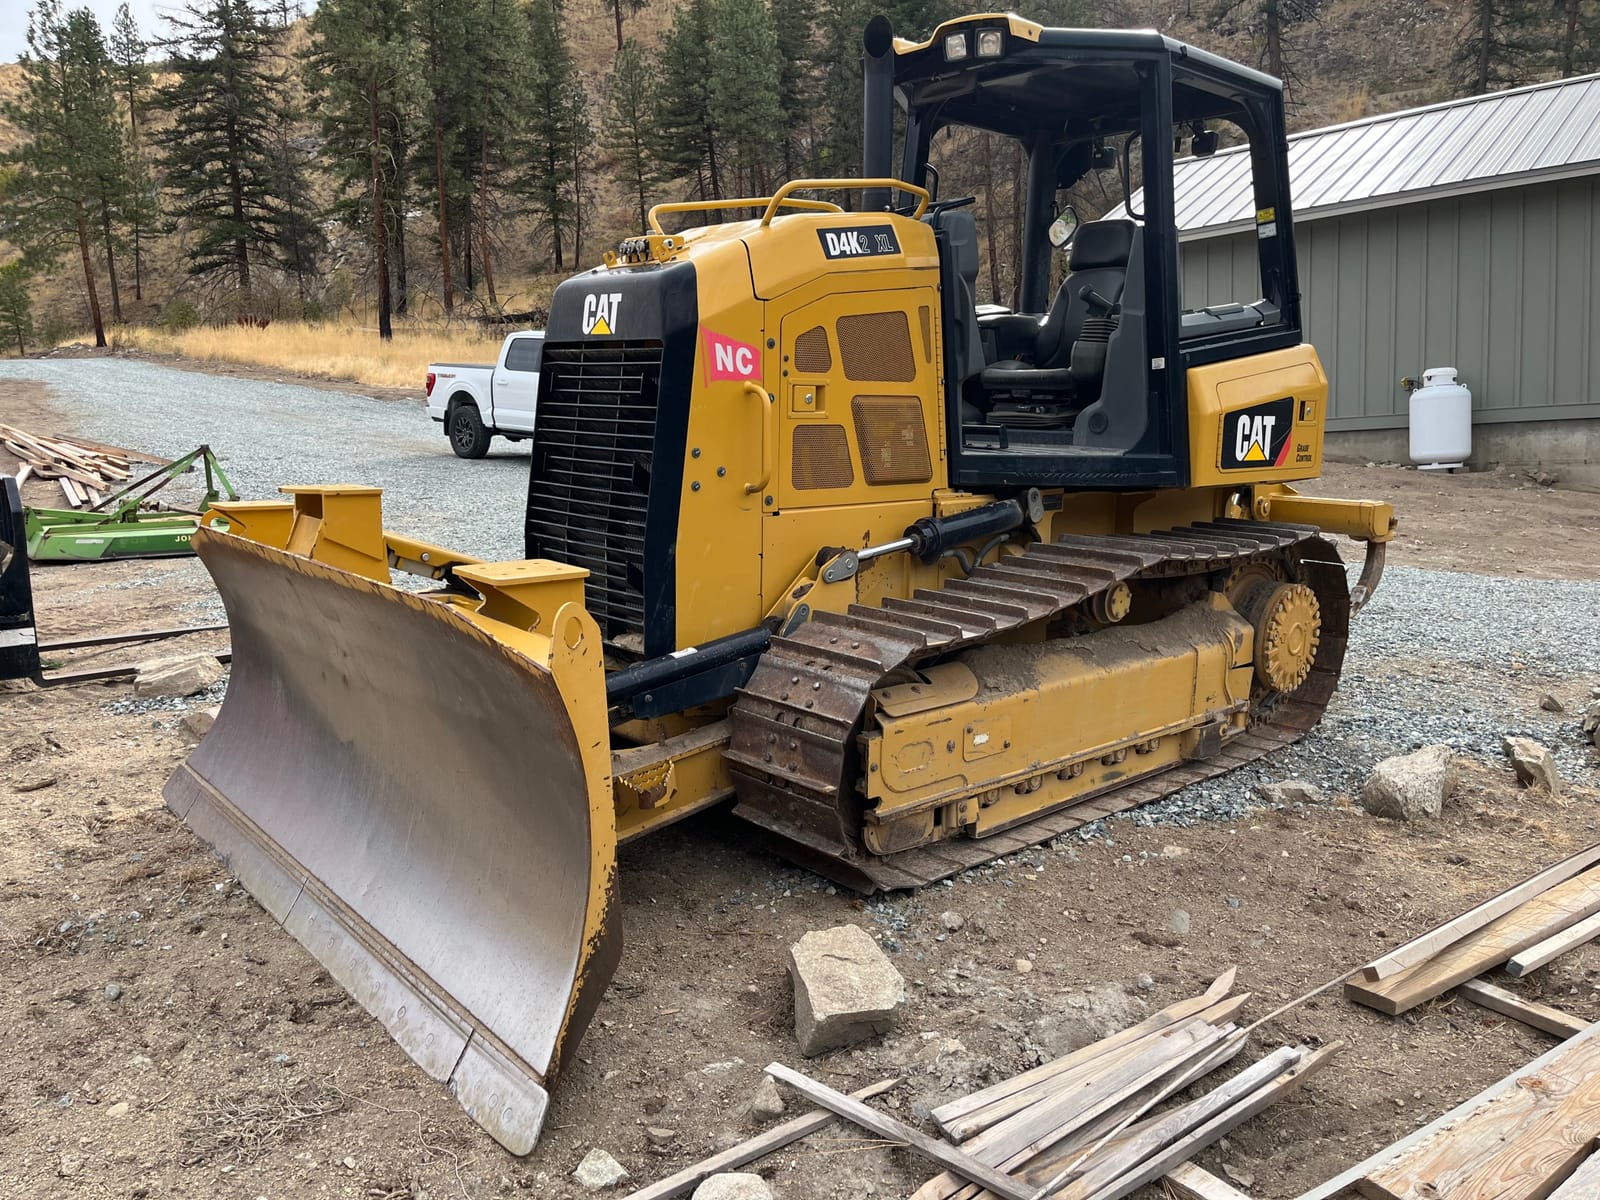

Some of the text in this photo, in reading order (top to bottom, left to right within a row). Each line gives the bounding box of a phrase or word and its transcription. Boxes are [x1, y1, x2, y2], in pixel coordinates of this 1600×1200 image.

[874, 233, 894, 253] XL
[582, 293, 622, 335] CAT
[714, 342, 753, 375] NC
[1235, 414, 1276, 462] CAT
